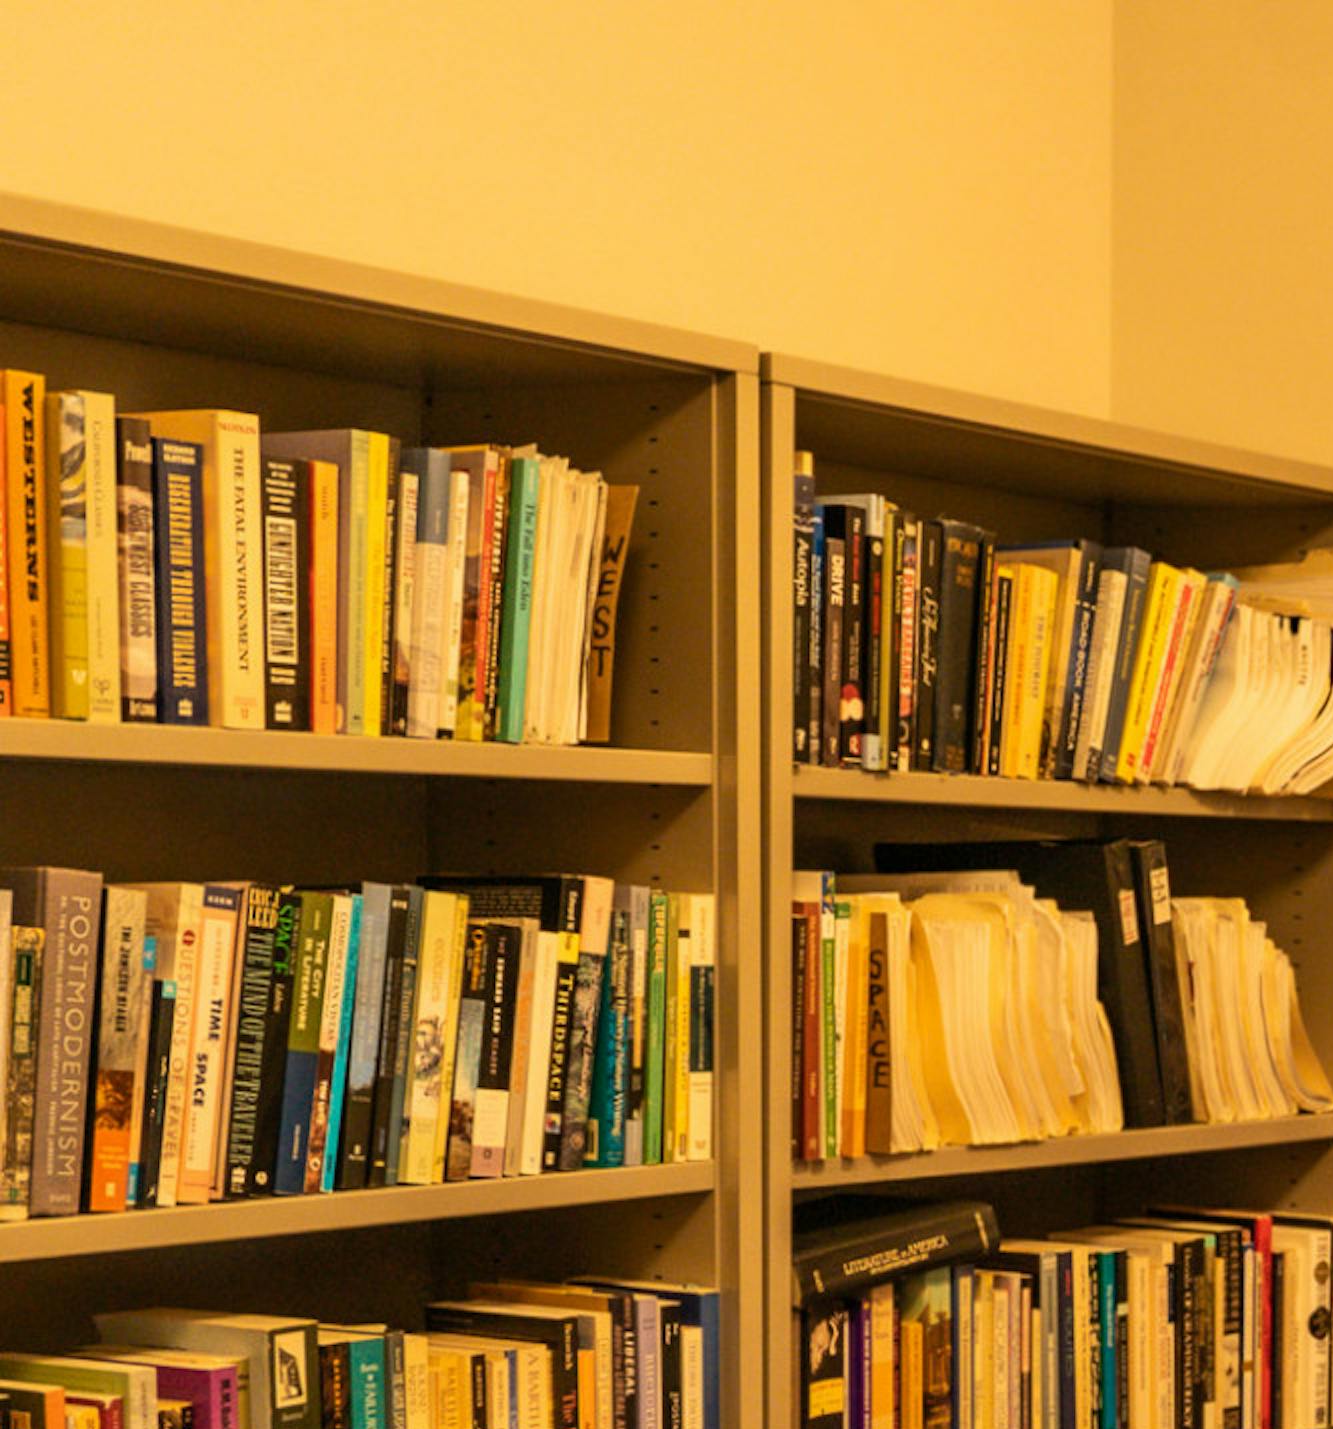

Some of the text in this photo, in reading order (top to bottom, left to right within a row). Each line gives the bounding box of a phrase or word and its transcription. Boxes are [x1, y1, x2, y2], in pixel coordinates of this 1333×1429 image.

[21, 383, 39, 603] WESTERNS
[128, 504, 152, 638] SOUTHWEST CLASSICS
[167, 473, 196, 688] REGENERATION THROUGH VIOLENCE
[232, 448, 250, 674] THE FATAL ENVIRONMENT
[268, 522, 297, 657] GUNFIGHTER NATION
[591, 535, 624, 678] WEST
[794, 538, 810, 606] Autopia
[830, 555, 844, 606] DRIVE
[1066, 692, 1082, 752] AMERICA
[56, 895, 92, 1177] POSTMODERNISM
[207, 998, 224, 1042] TIME
[230, 931, 274, 1165] THE MIND OF THE TRAVELER
[296, 955, 313, 1030] LITERATURE
[311, 969, 323, 998] CITY
[547, 974, 574, 1103] THIRDSPACE
[867, 950, 891, 1091] SPACE
[191, 1052, 209, 1108] SPACE
